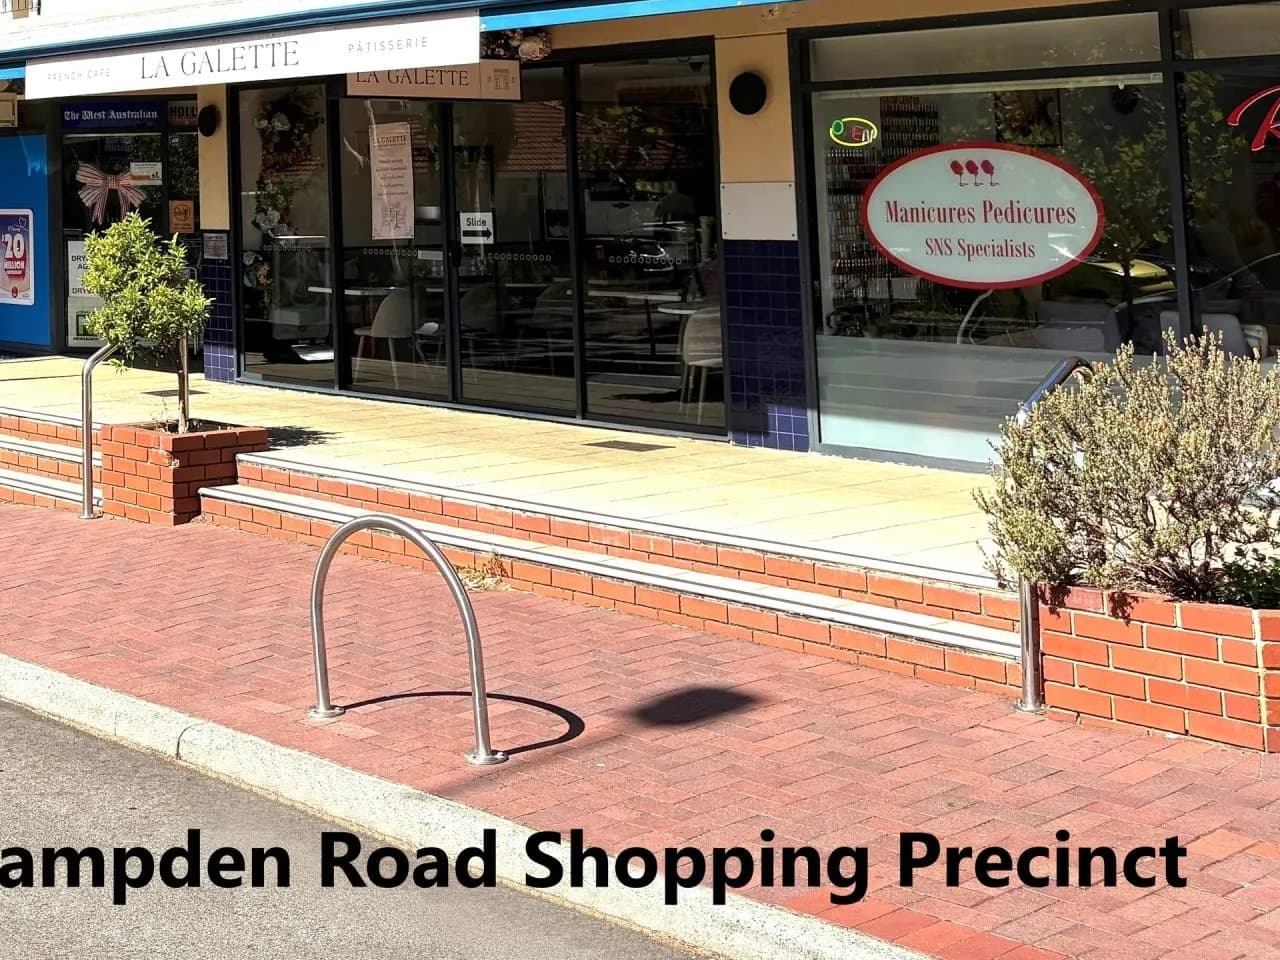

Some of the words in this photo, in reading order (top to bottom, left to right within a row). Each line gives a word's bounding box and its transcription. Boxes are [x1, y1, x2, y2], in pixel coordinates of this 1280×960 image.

[141, 55, 170, 80] LA
[180, 40, 299, 76] GALETTE
[356, 70, 380, 84] LA
[386, 69, 469, 86] GALETTE
[64, 110, 80, 120] The
[82, 109, 106, 120] West
[108, 109, 158, 120] Australian
[466, 217, 487, 227] Slide
[885, 200, 976, 224] Manicures
[982, 199, 1076, 224] Pedicures
[925, 237, 953, 257] SNS
[957, 239, 1036, 262] Specialists
